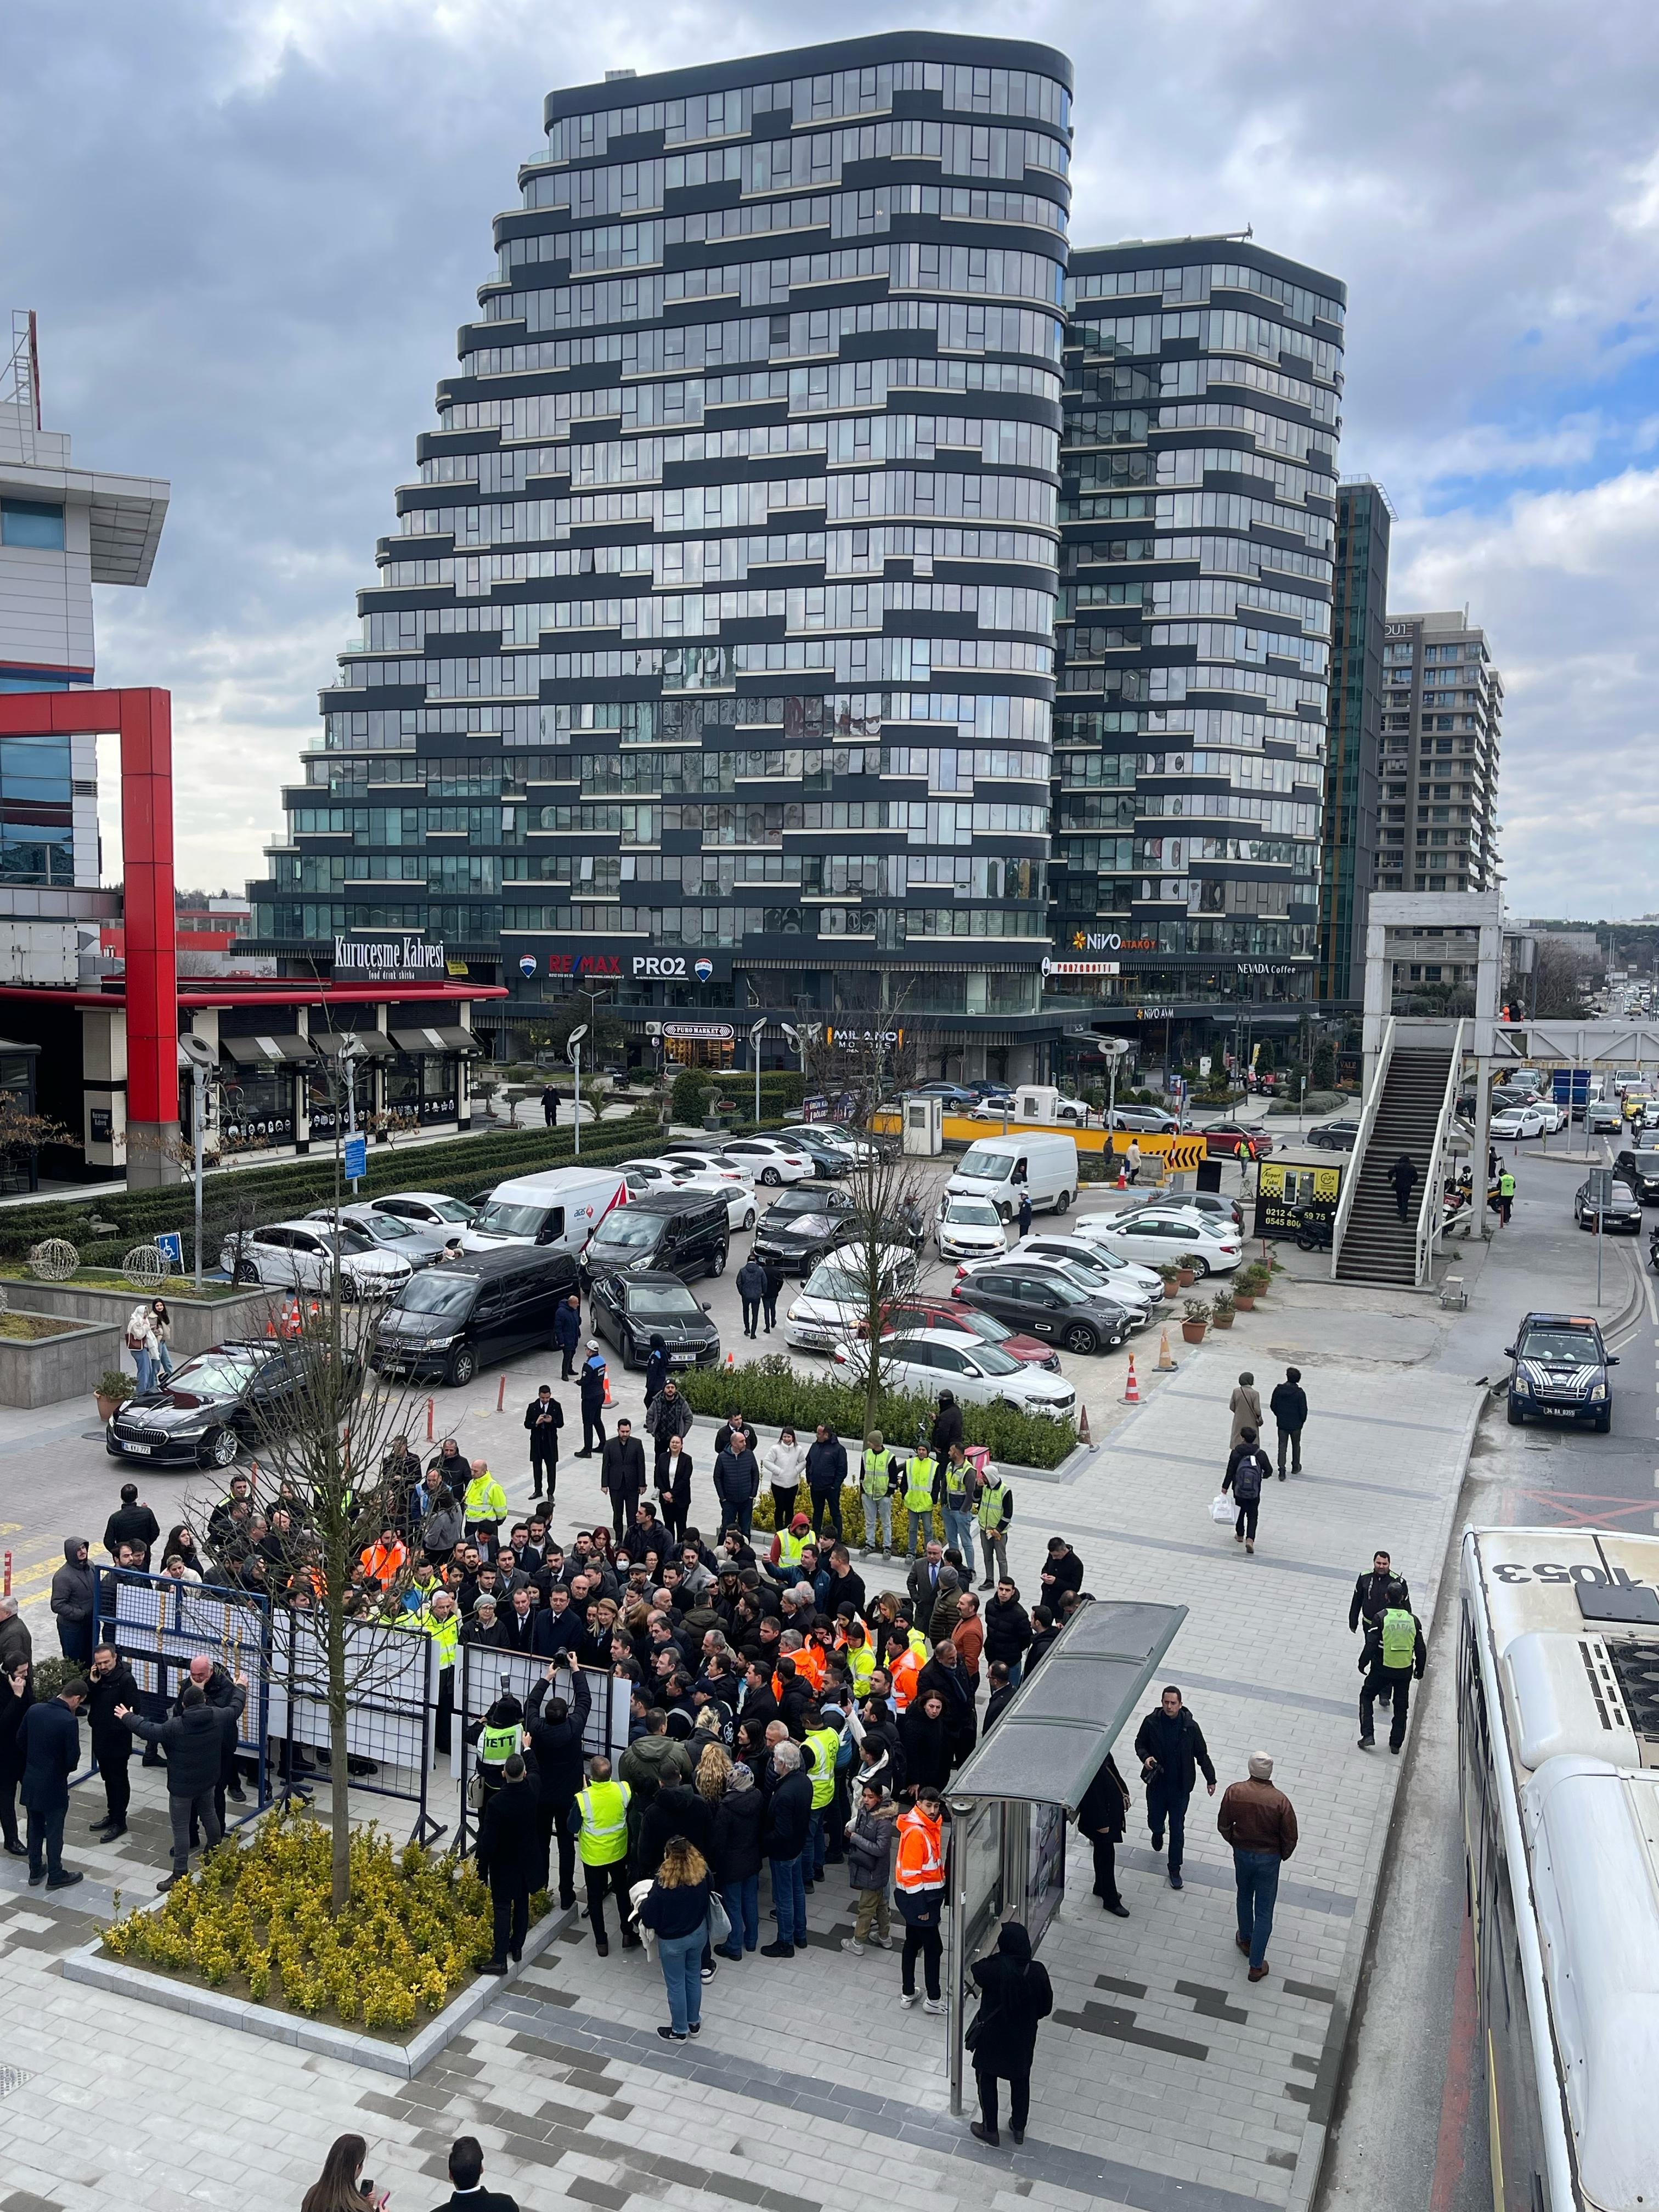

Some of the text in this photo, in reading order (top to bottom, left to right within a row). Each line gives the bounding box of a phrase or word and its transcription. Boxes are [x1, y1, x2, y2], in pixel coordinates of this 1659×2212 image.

[334, 935, 444, 970] Kuruçeşme Kahvesi
[549, 955, 686, 975] RE/MAX PRO2
[1238, 963, 1296, 973] NEVADA Coffee
[369, 970, 415, 980] food drink shisha
[1266, 1208, 1285, 1217] 0212
[1316, 1212, 1325, 1221] 75
[1265, 1217, 1285, 1226] 0545
[1492, 1564, 1643, 1587] 1053
